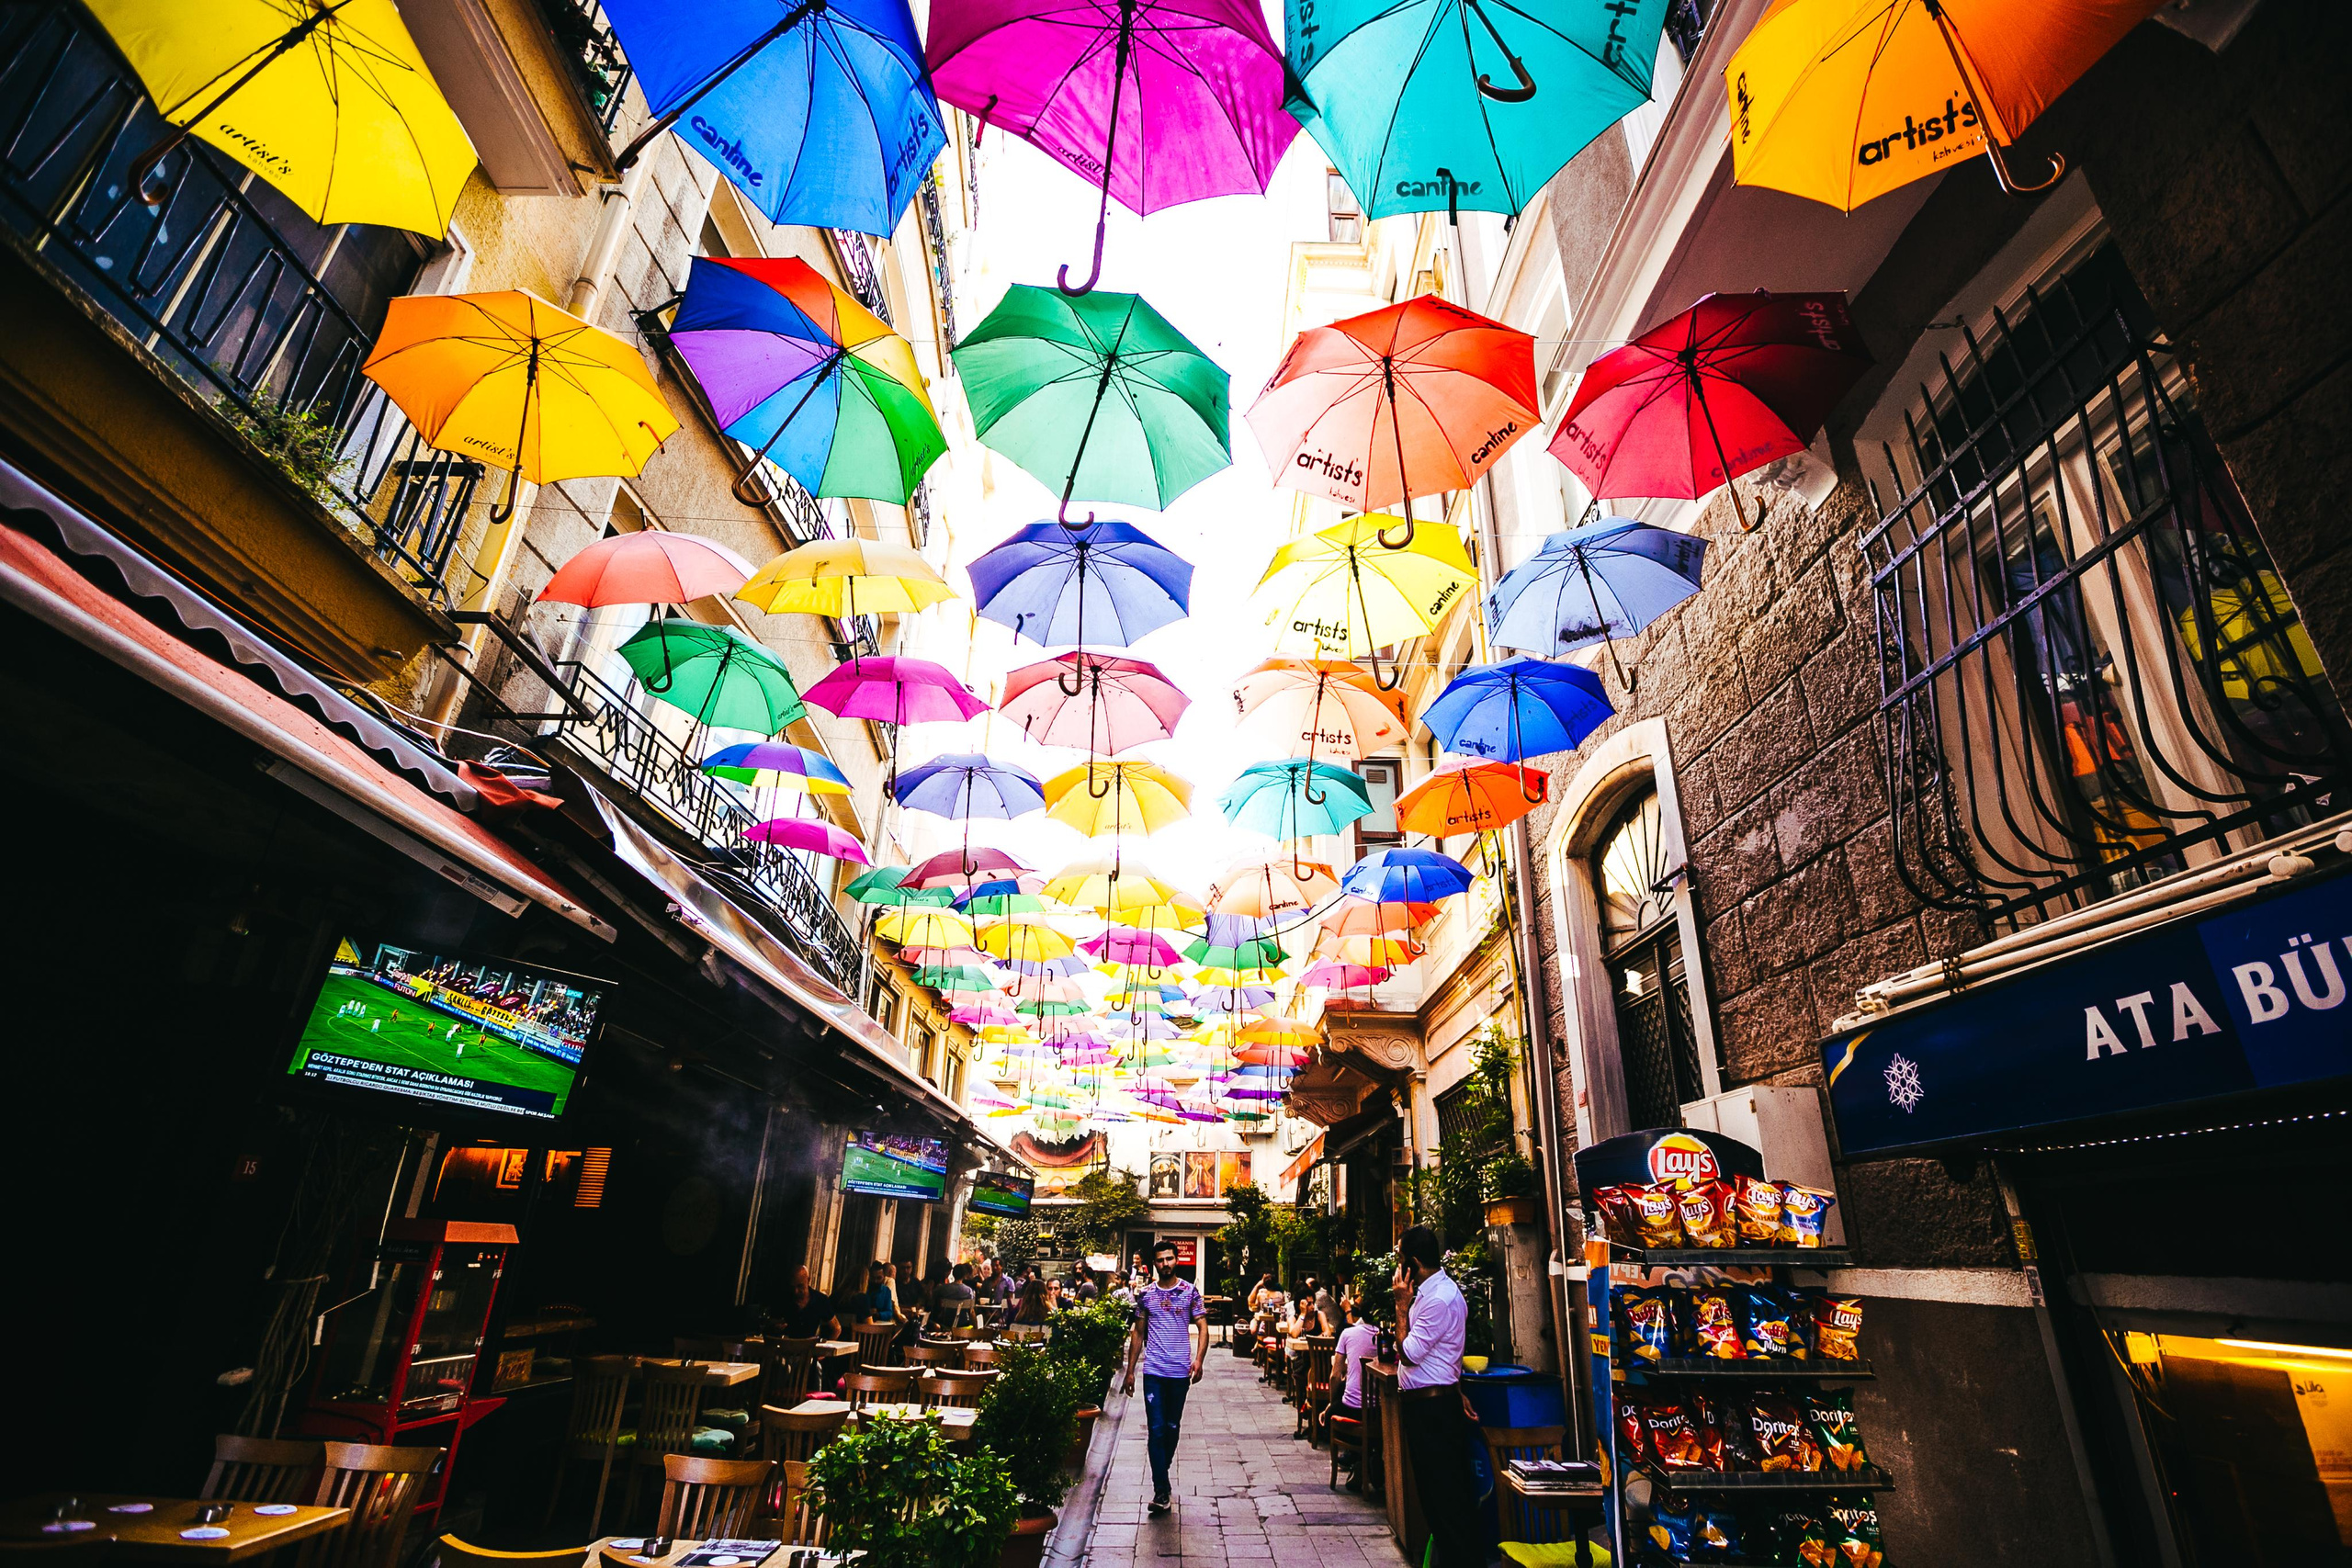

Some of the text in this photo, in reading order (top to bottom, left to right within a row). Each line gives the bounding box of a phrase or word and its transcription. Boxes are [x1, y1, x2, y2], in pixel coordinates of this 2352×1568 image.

[220, 124, 293, 175] artist's
[690, 115, 763, 187] cantine
[1471, 422, 1518, 465] cantine
[1430, 581, 1460, 616] cantine
[394, 983, 416, 998] FUTON
[2084, 933, 2352, 1061] ATA BÜ
[311, 1053, 474, 1089] GÖZTEPE'DEN STAT AÇIKLAMASI
[243, 1160, 256, 1175] 15
[1657, 1148, 1713, 1187] Lay's
